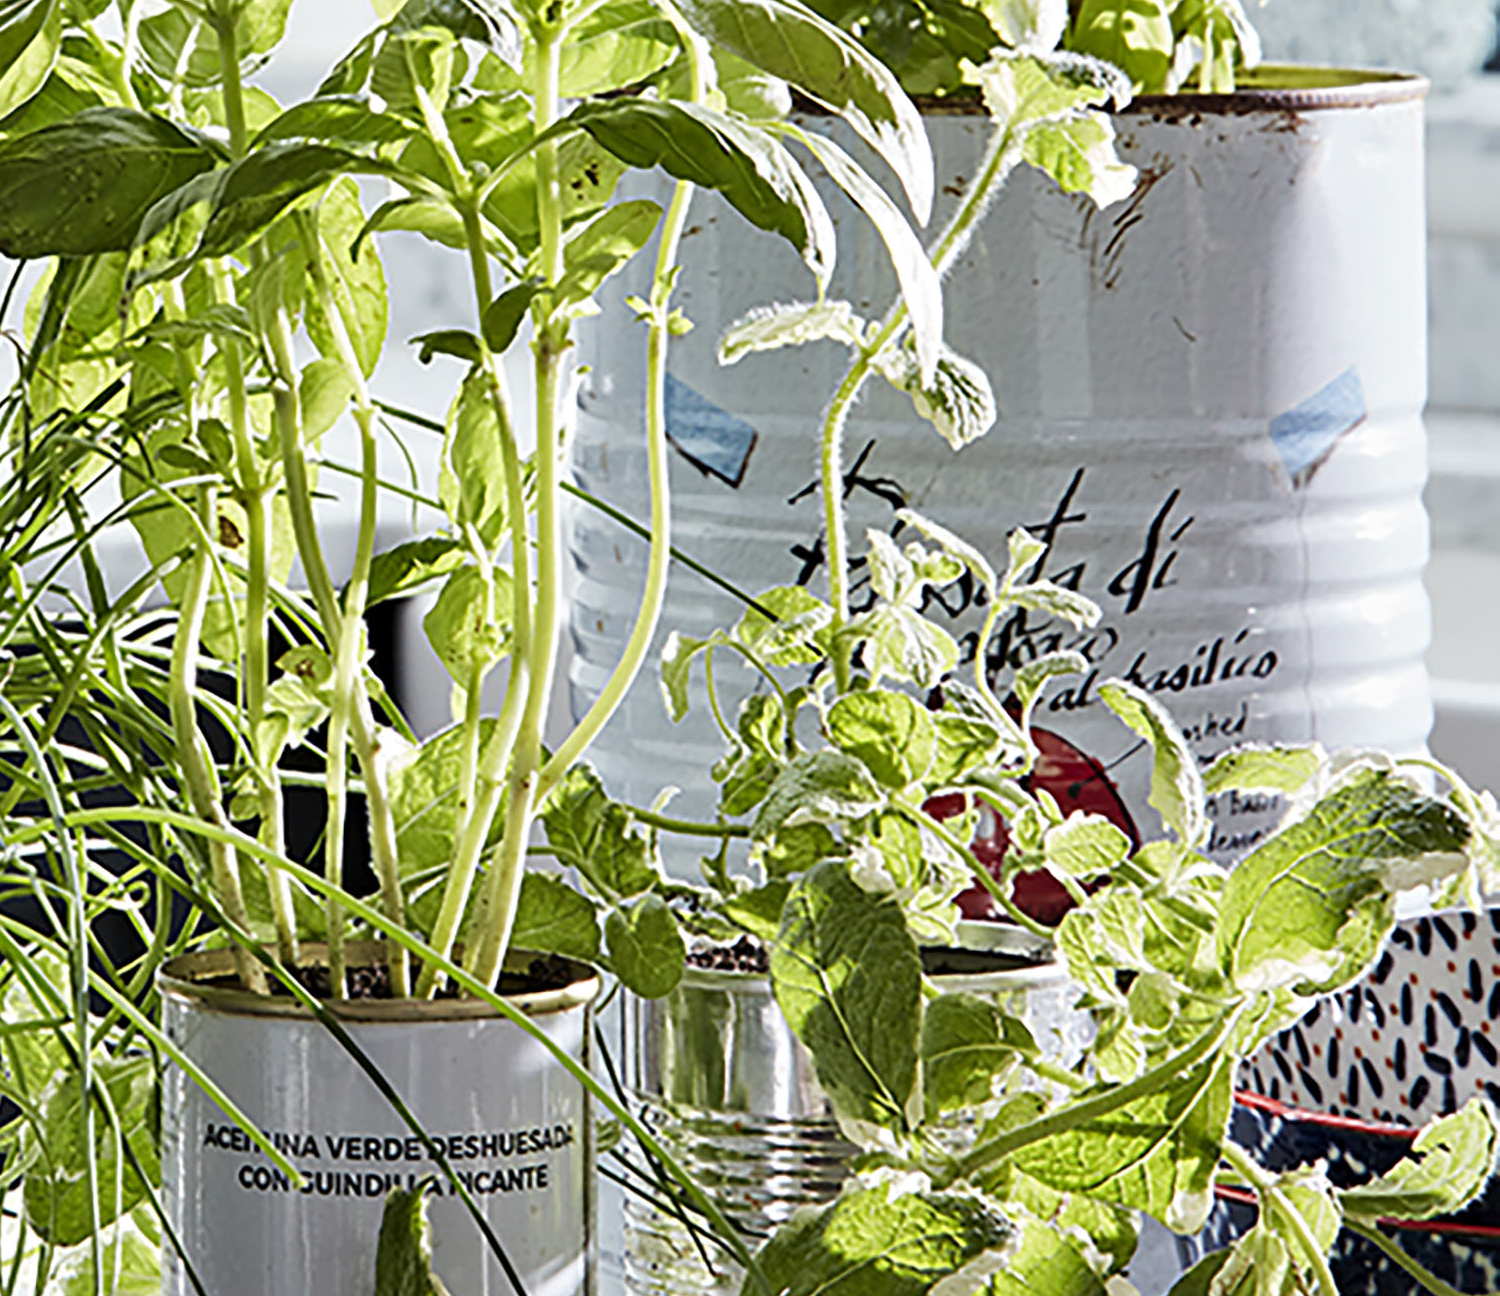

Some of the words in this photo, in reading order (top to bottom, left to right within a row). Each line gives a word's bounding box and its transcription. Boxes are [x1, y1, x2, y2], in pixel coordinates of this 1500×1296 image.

[1108, 488, 1194, 614] di
[1048, 669, 1101, 711] al
[324, 1134, 422, 1161] VERDE
[238, 1164, 289, 1192] CON
